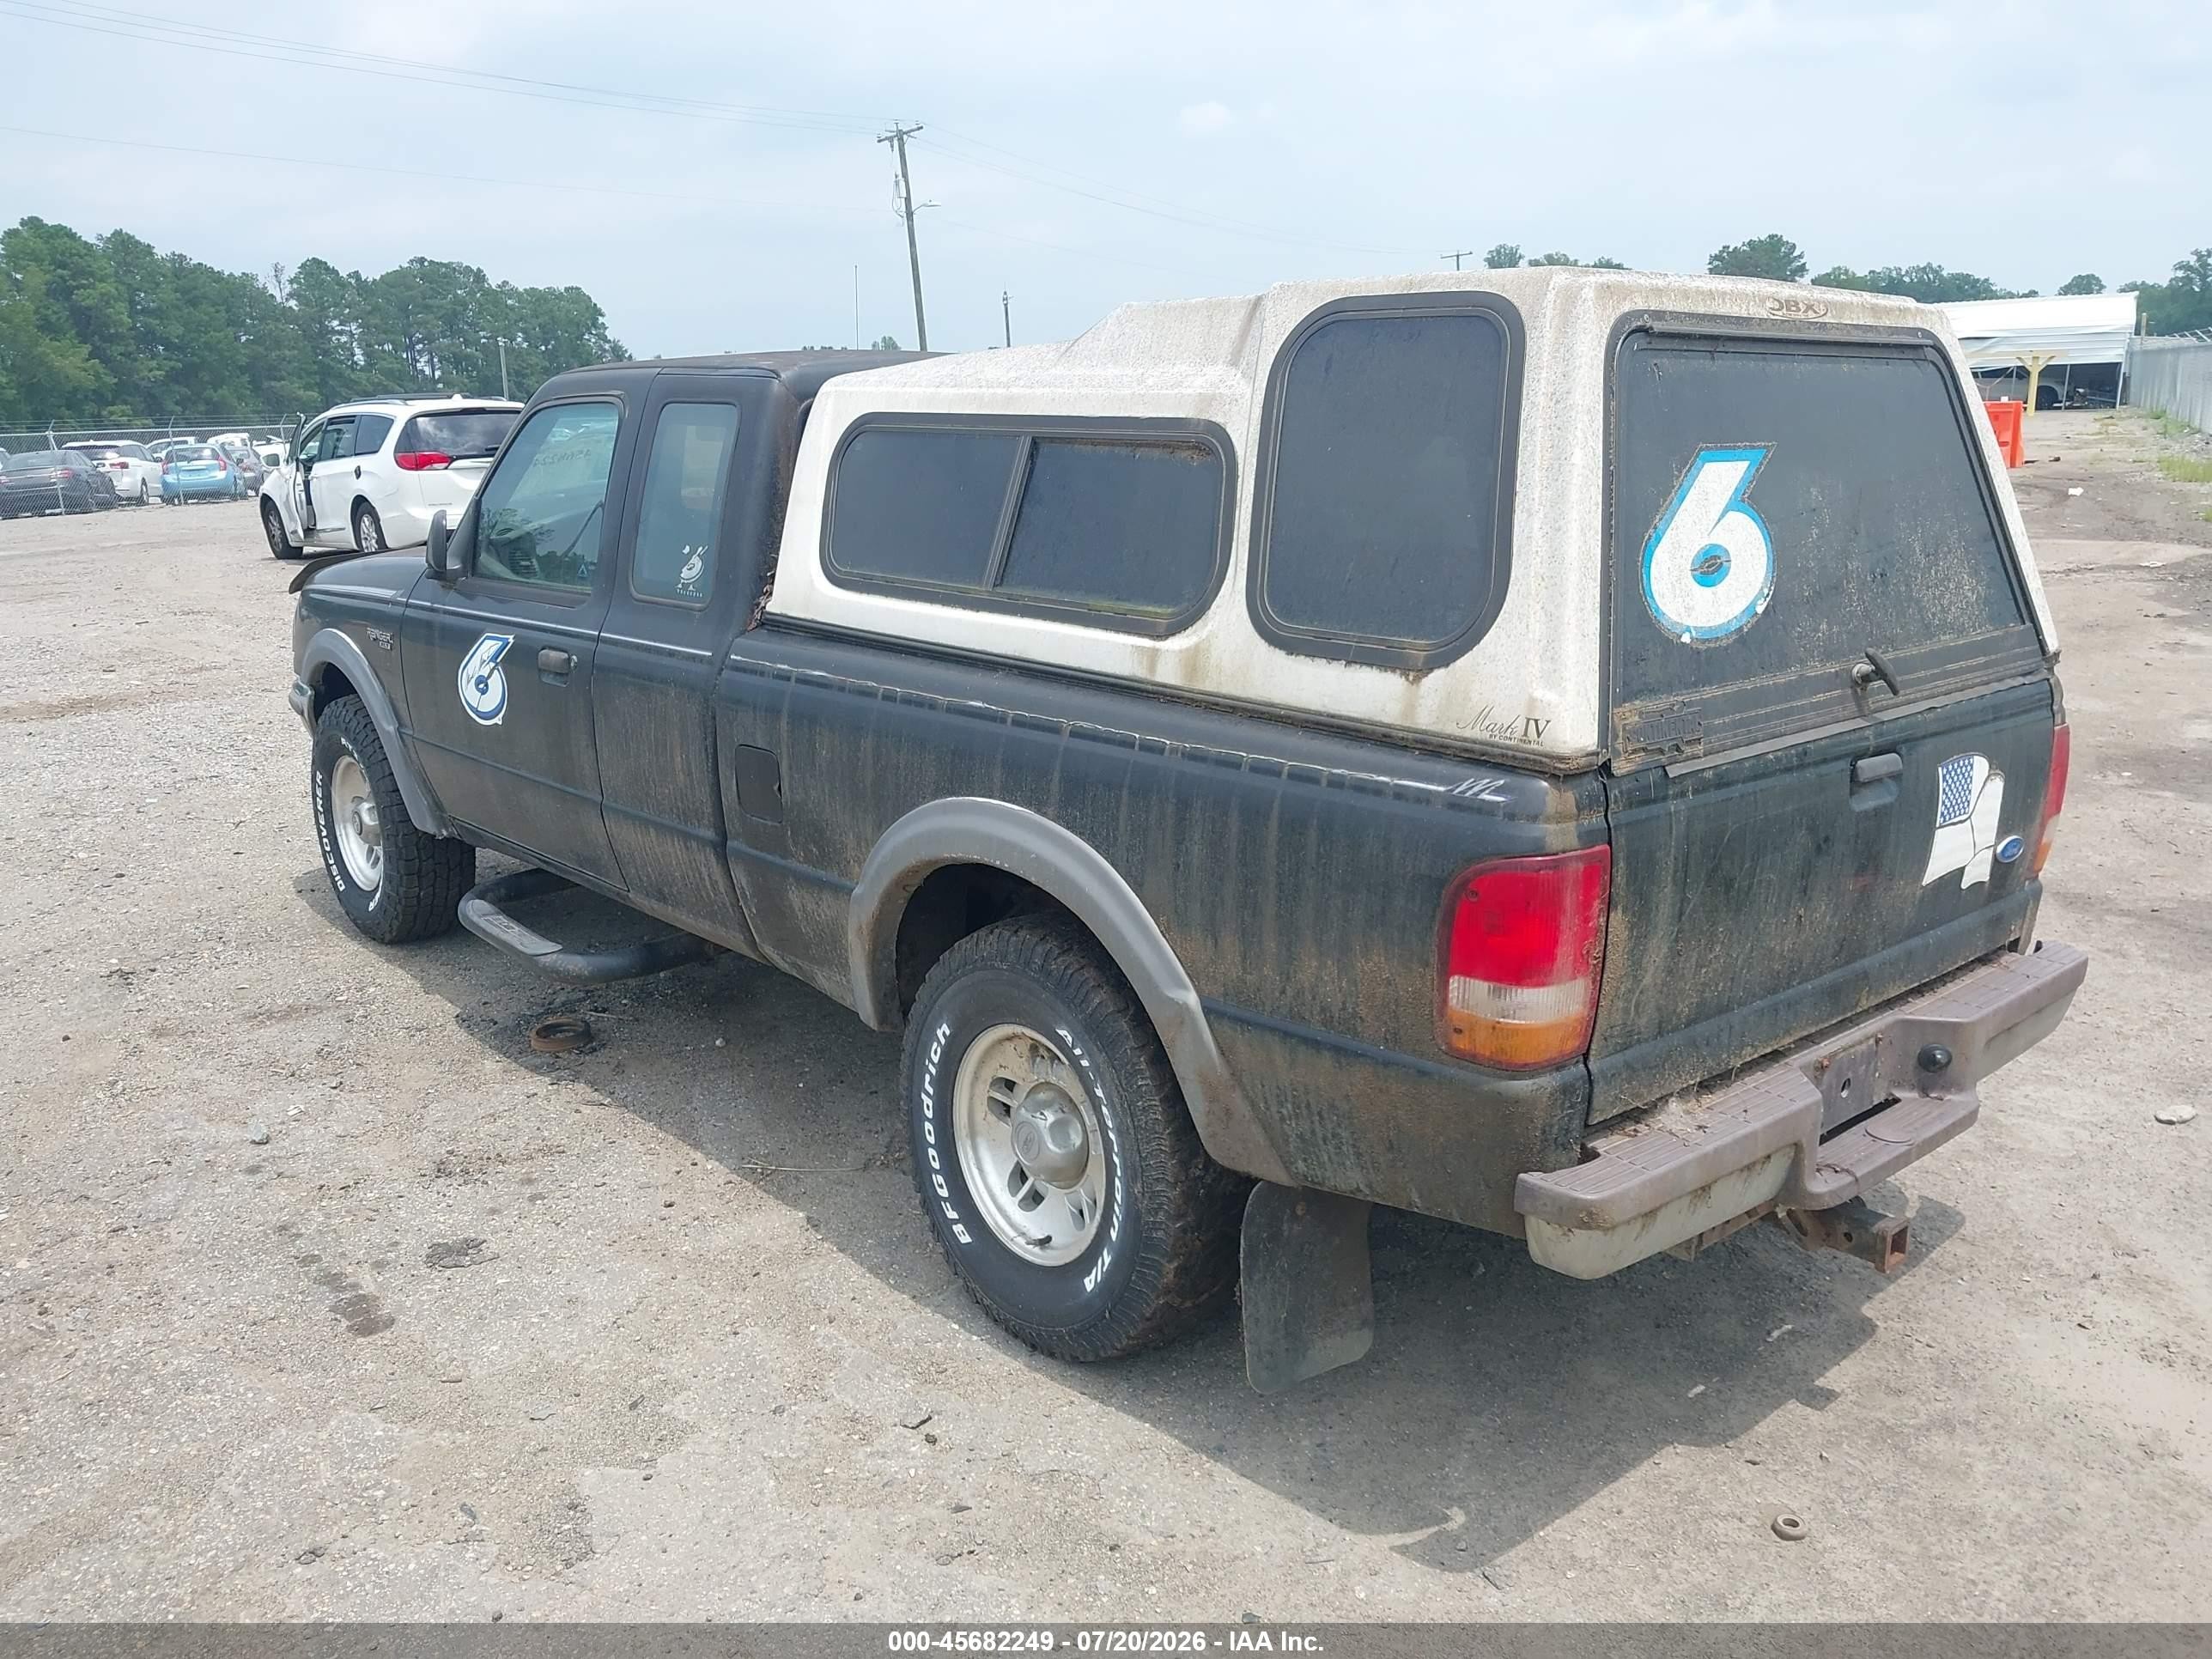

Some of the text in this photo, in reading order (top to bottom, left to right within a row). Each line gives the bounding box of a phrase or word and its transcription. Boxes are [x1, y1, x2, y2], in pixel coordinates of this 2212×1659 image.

[1640, 447, 1776, 640] 6
[458, 633, 515, 725] 6
[1456, 704, 1552, 739] Mark IV
[1498, 734, 1544, 747] CONTINENTAL
[315, 770, 346, 892] DISCOVERER
[921, 1023, 972, 1244] BFGoodrich
[1055, 1029, 1121, 1242] All-Terrain
